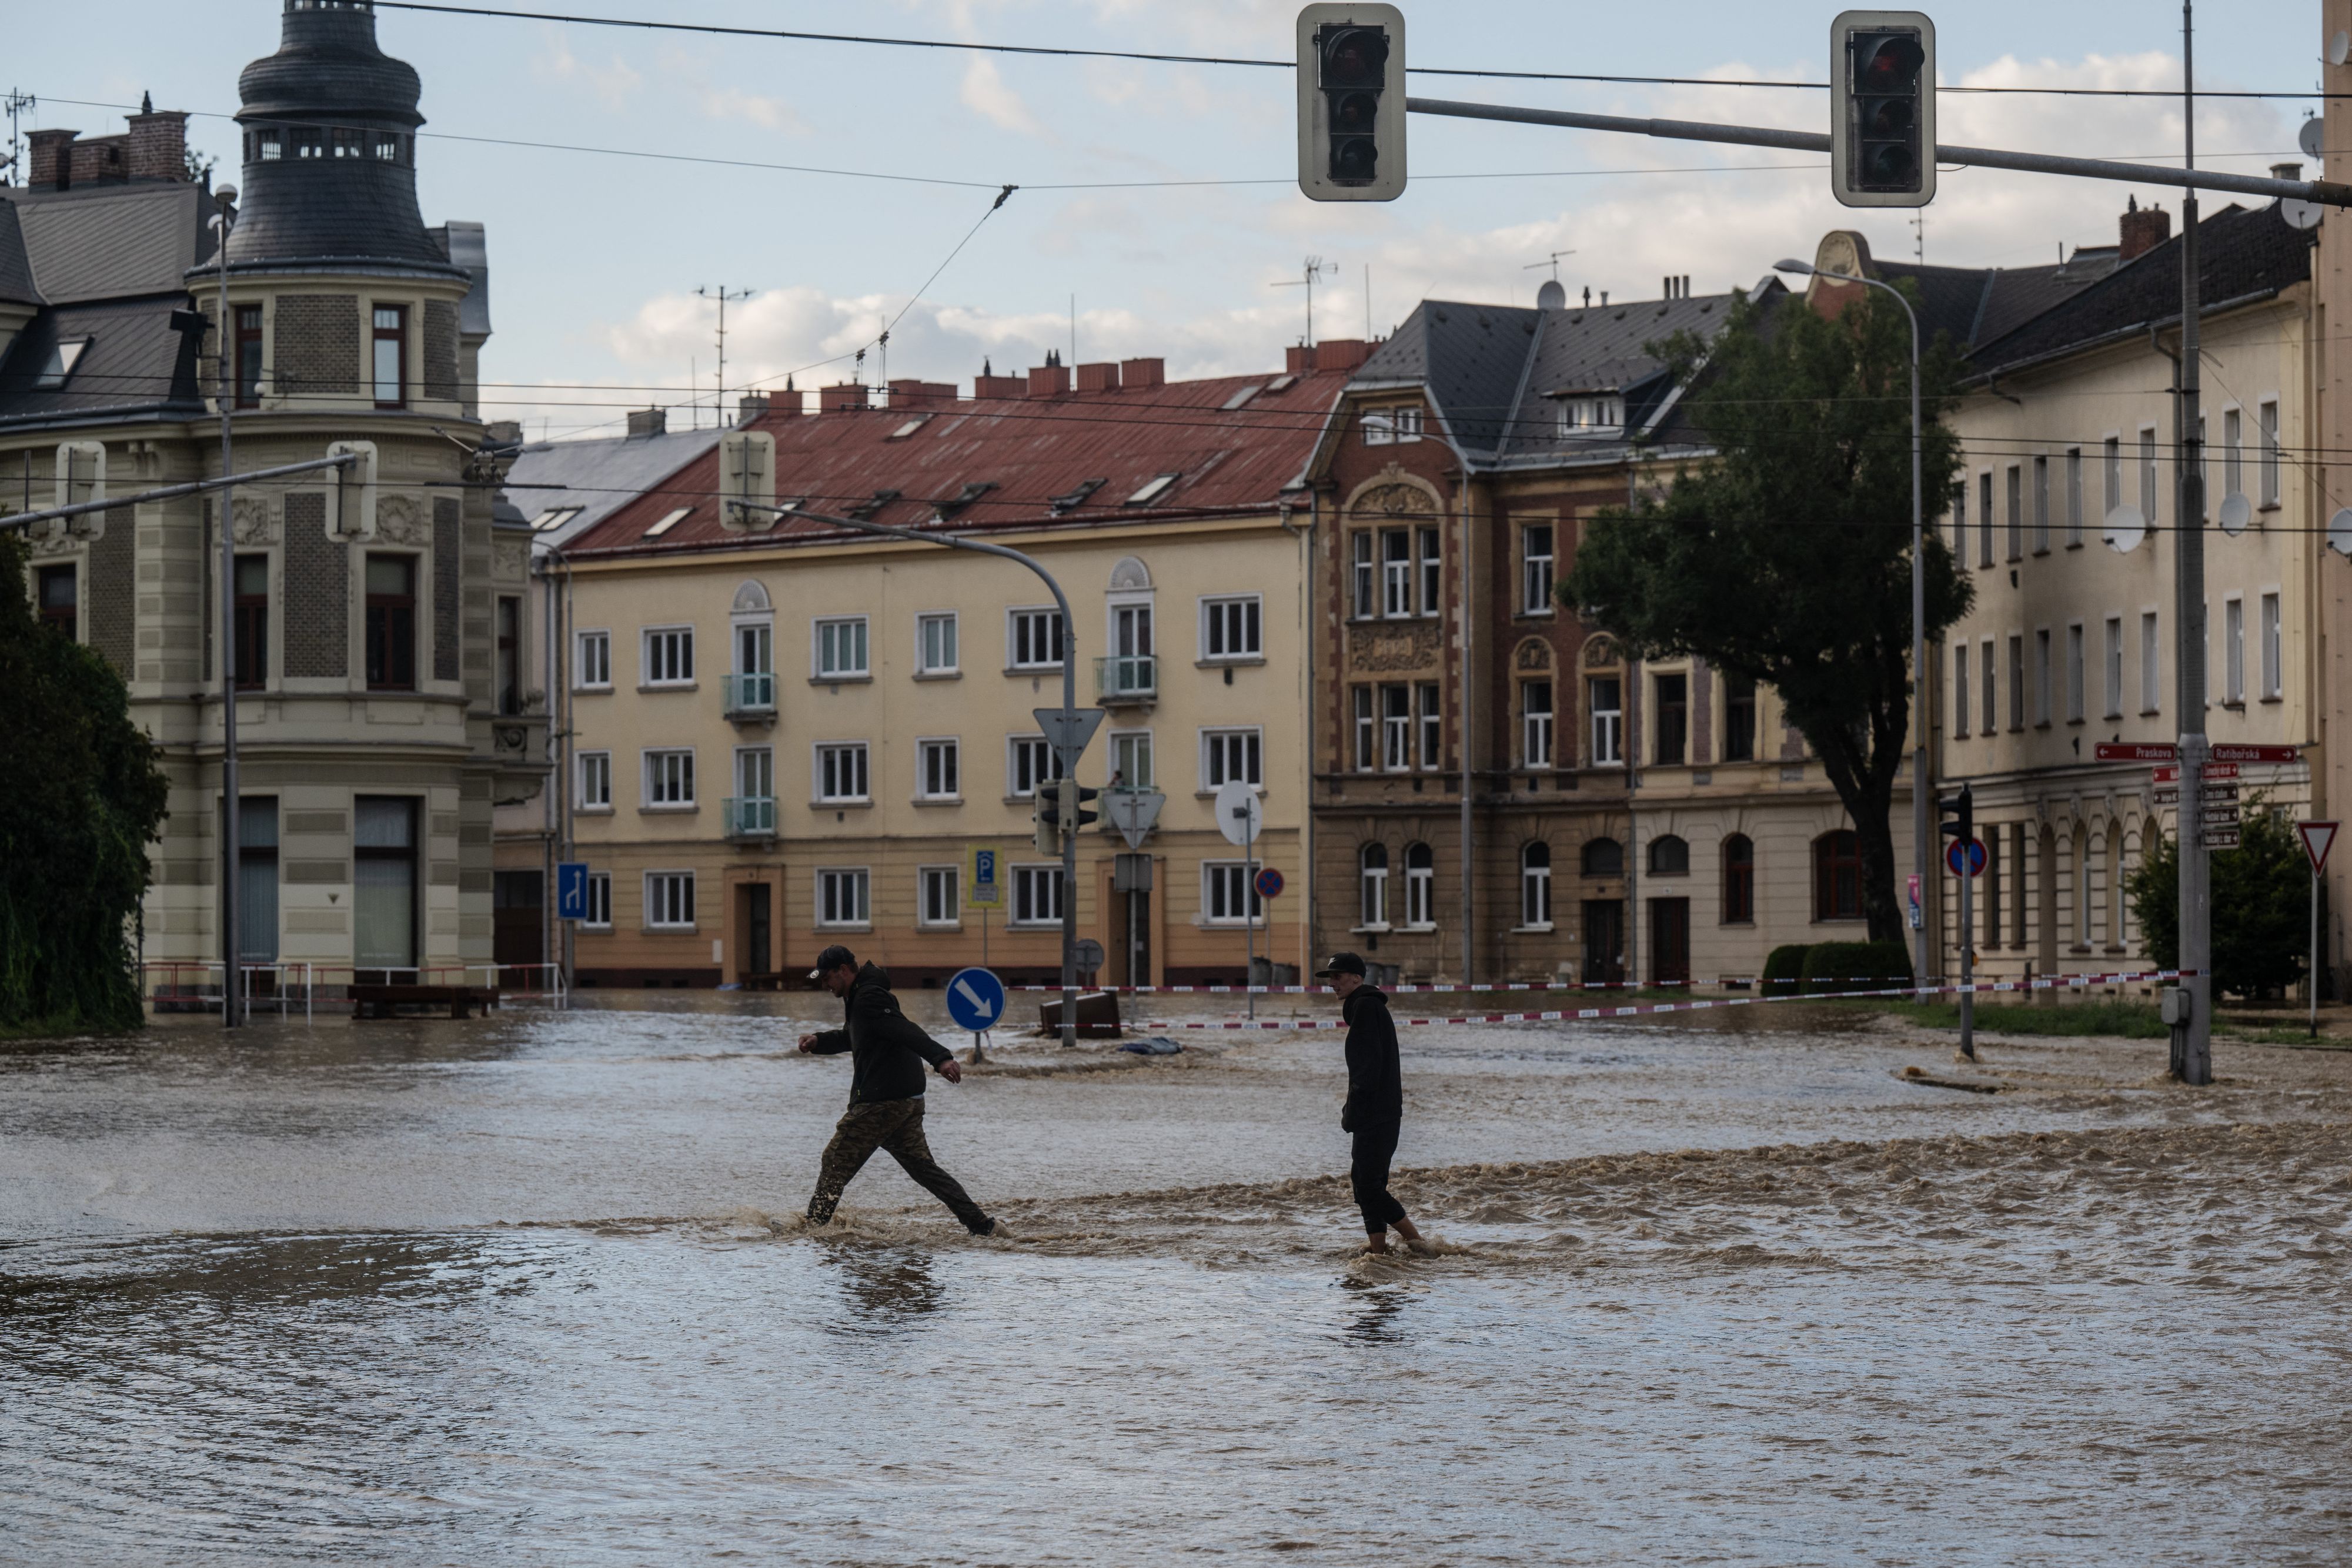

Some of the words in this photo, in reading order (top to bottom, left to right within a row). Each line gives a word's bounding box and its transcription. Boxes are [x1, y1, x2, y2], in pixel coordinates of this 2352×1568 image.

[2136, 747, 2172, 758] Praskova
[2216, 748, 2260, 760] Ratibořská
[980, 858, 992, 875] P
